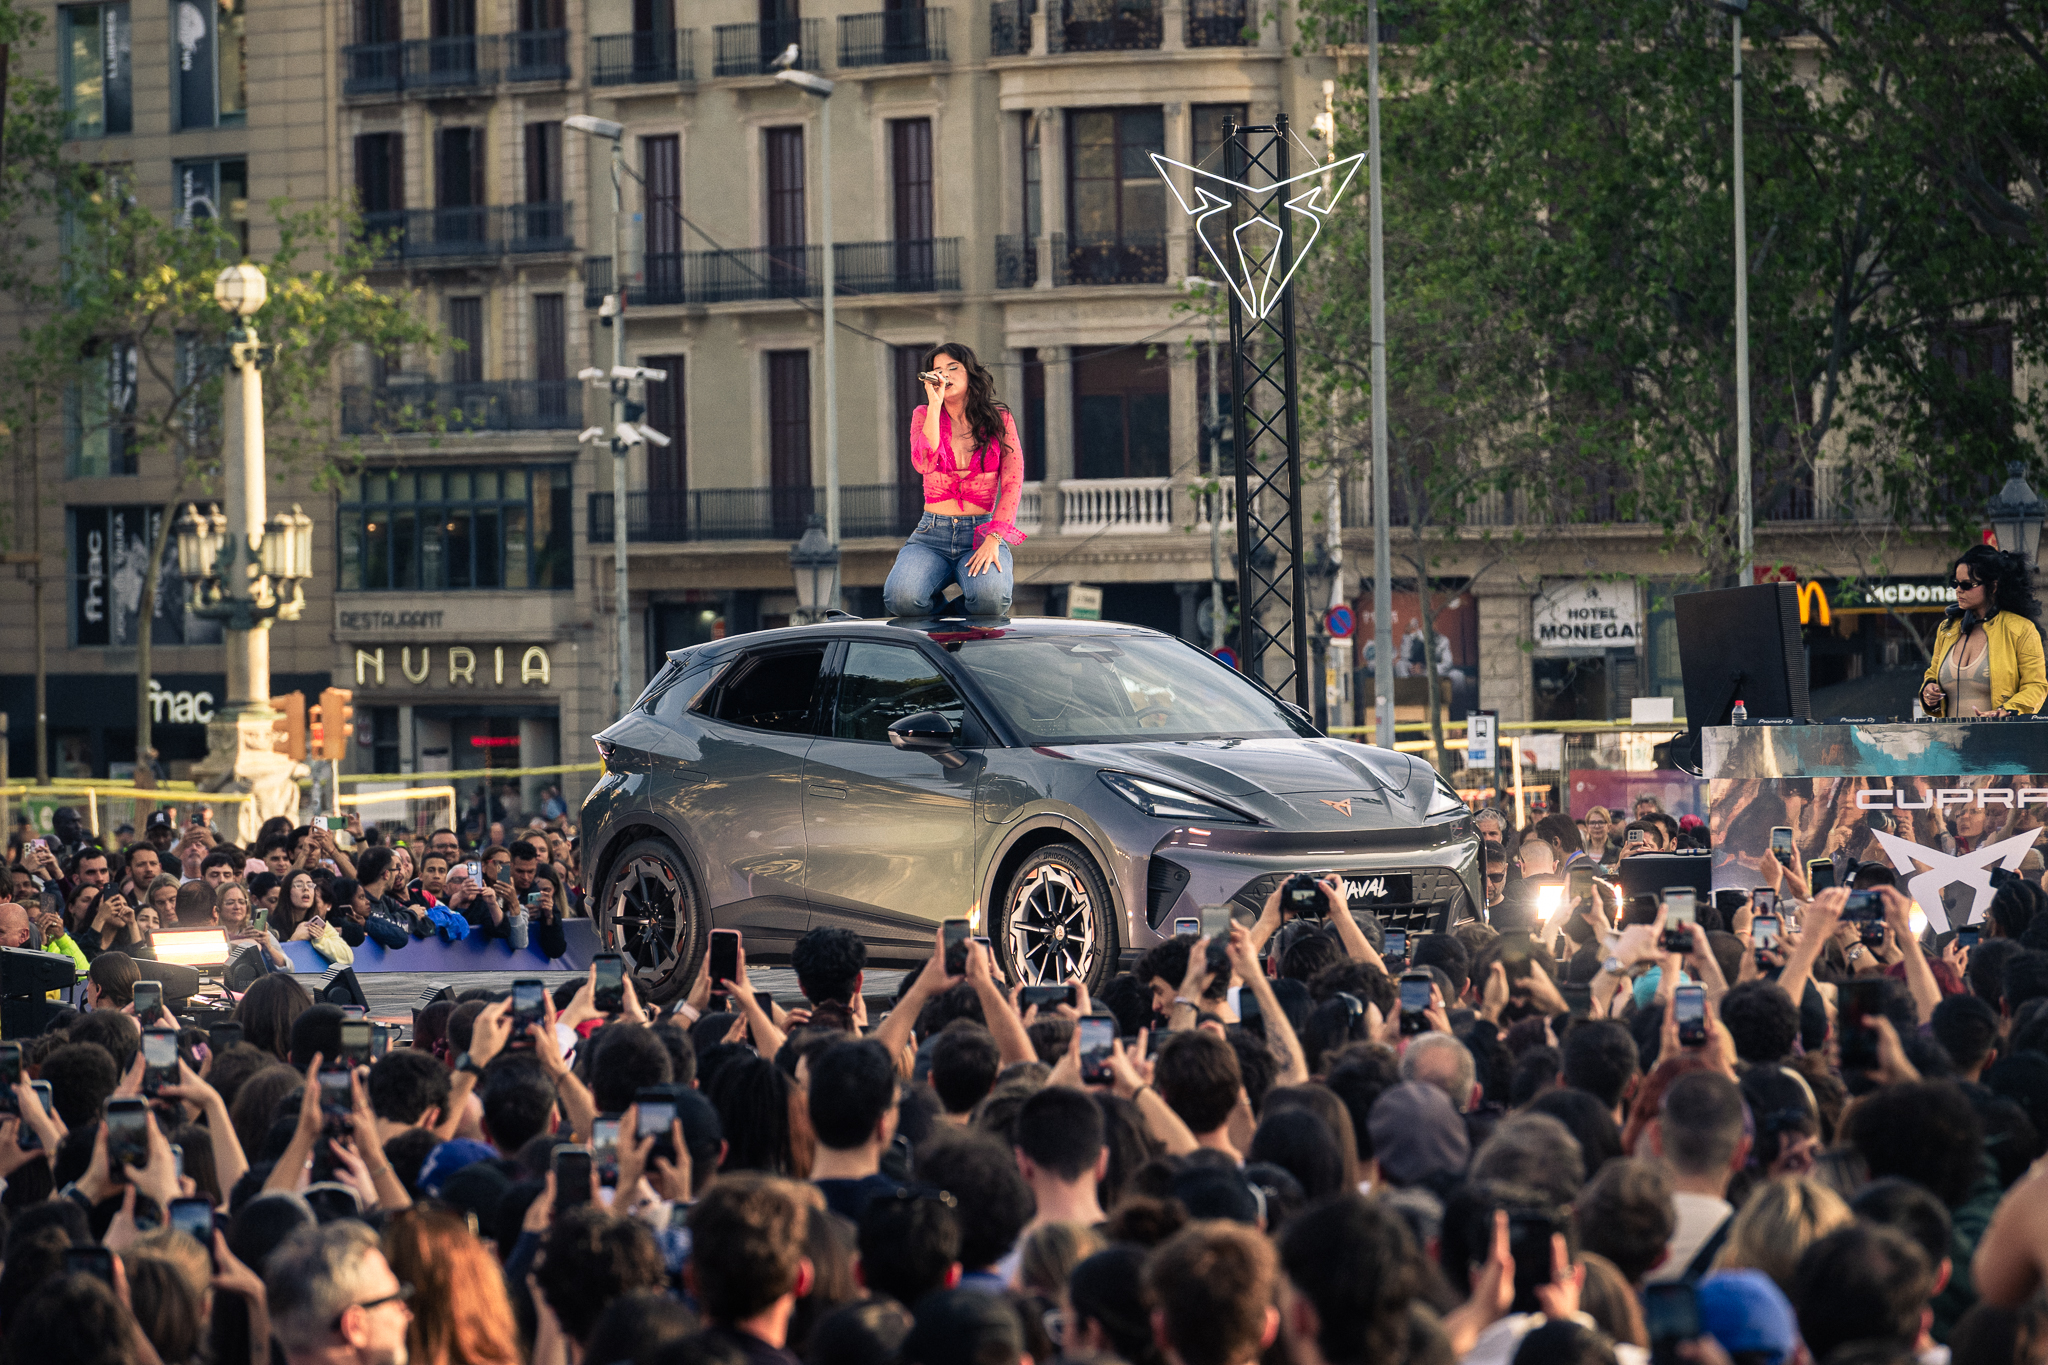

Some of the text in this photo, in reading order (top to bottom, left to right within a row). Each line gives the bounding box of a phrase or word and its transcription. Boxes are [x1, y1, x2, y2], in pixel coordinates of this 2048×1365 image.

[84, 529, 103, 623] fnac
[339, 610, 444, 630] RESTAURANT
[1568, 608, 1616, 619] HOTEL
[356, 646, 550, 685] NURIA
[1856, 788, 2048, 810] CUPRA
[1043, 851, 1081, 872] BRIDGESTONE
